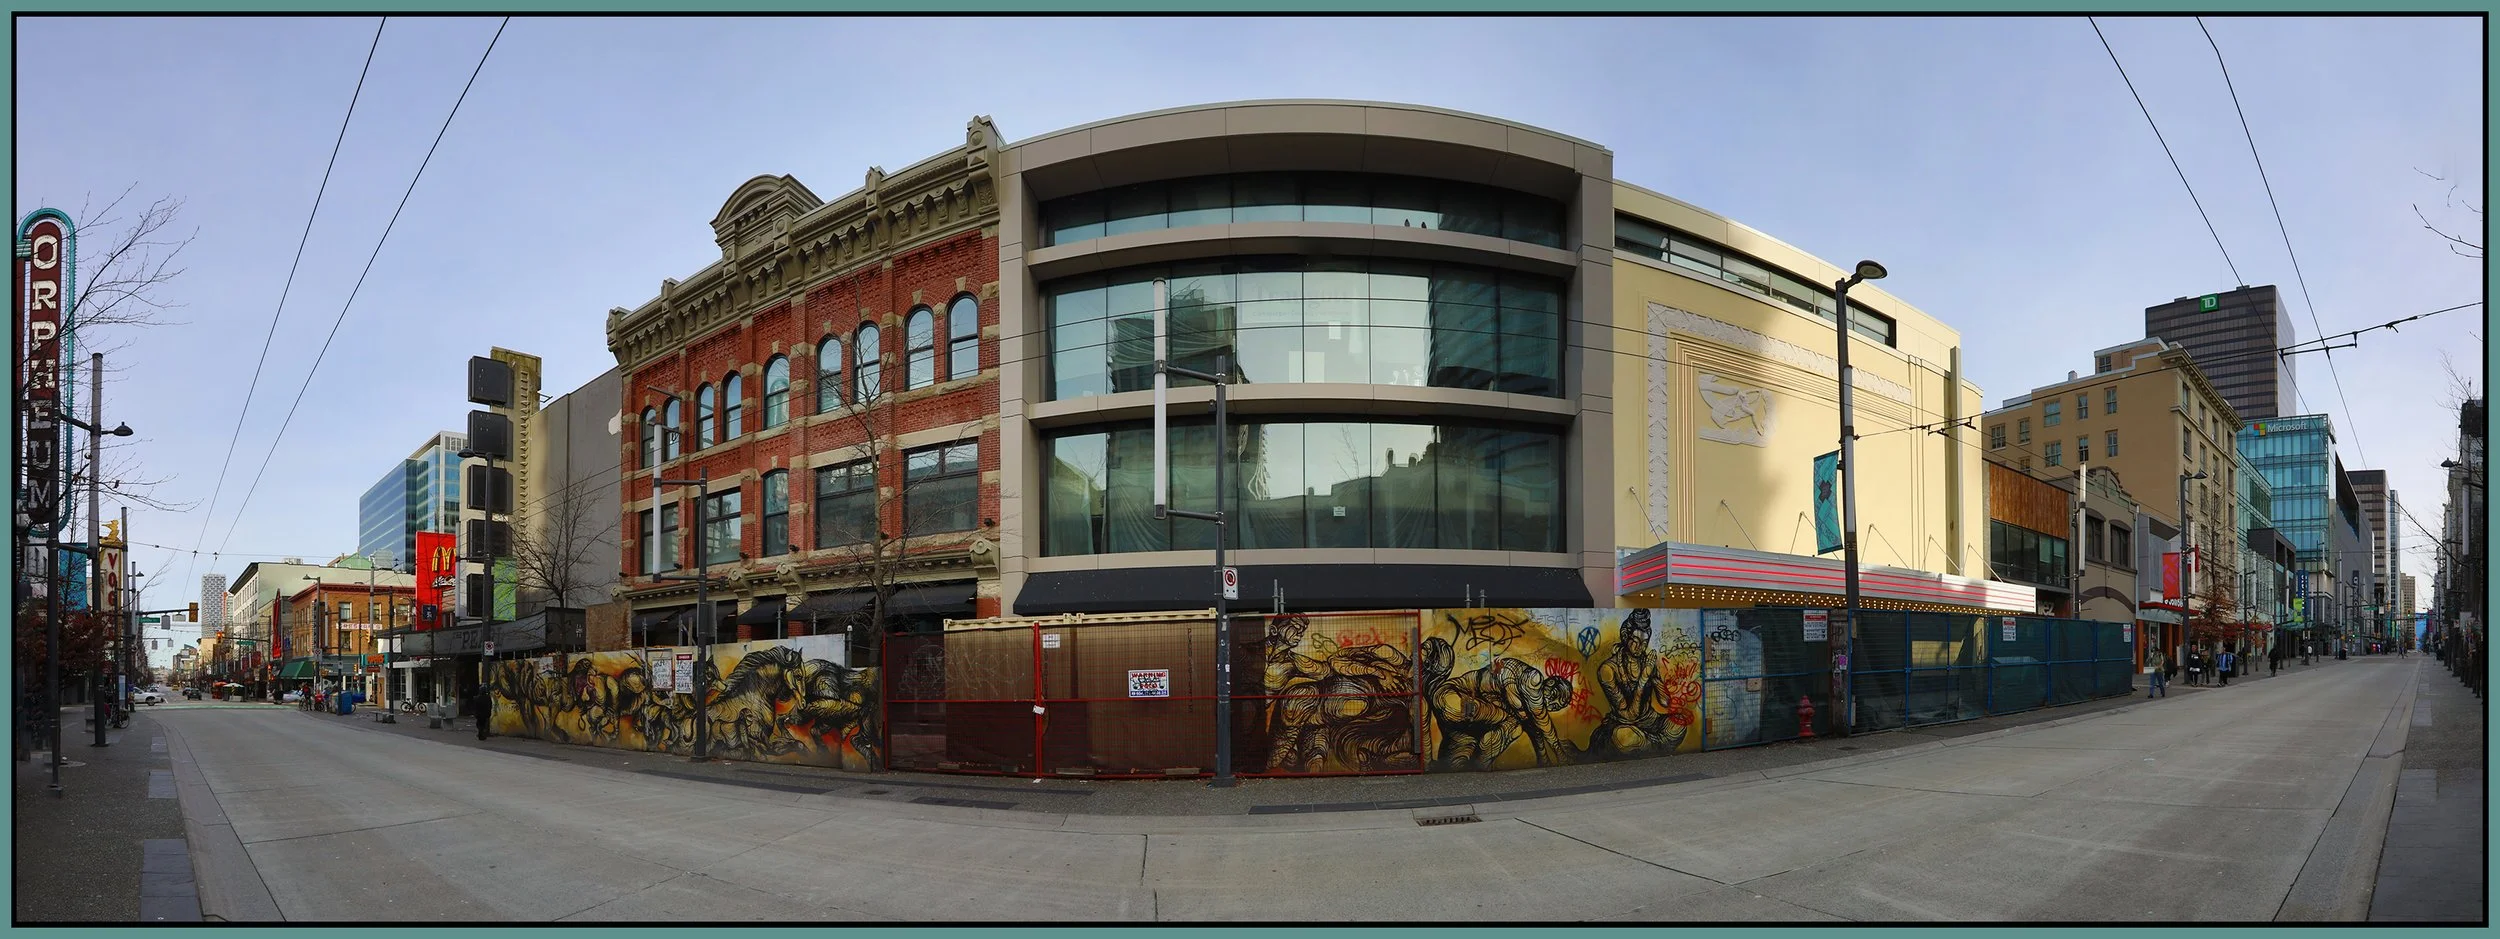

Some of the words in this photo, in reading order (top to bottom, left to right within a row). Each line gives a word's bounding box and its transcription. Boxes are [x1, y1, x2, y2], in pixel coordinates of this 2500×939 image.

[2202, 297, 2216, 308] TD
[30, 234, 58, 509] ORPHEUM
[2267, 421, 2308, 433] Microsoft
